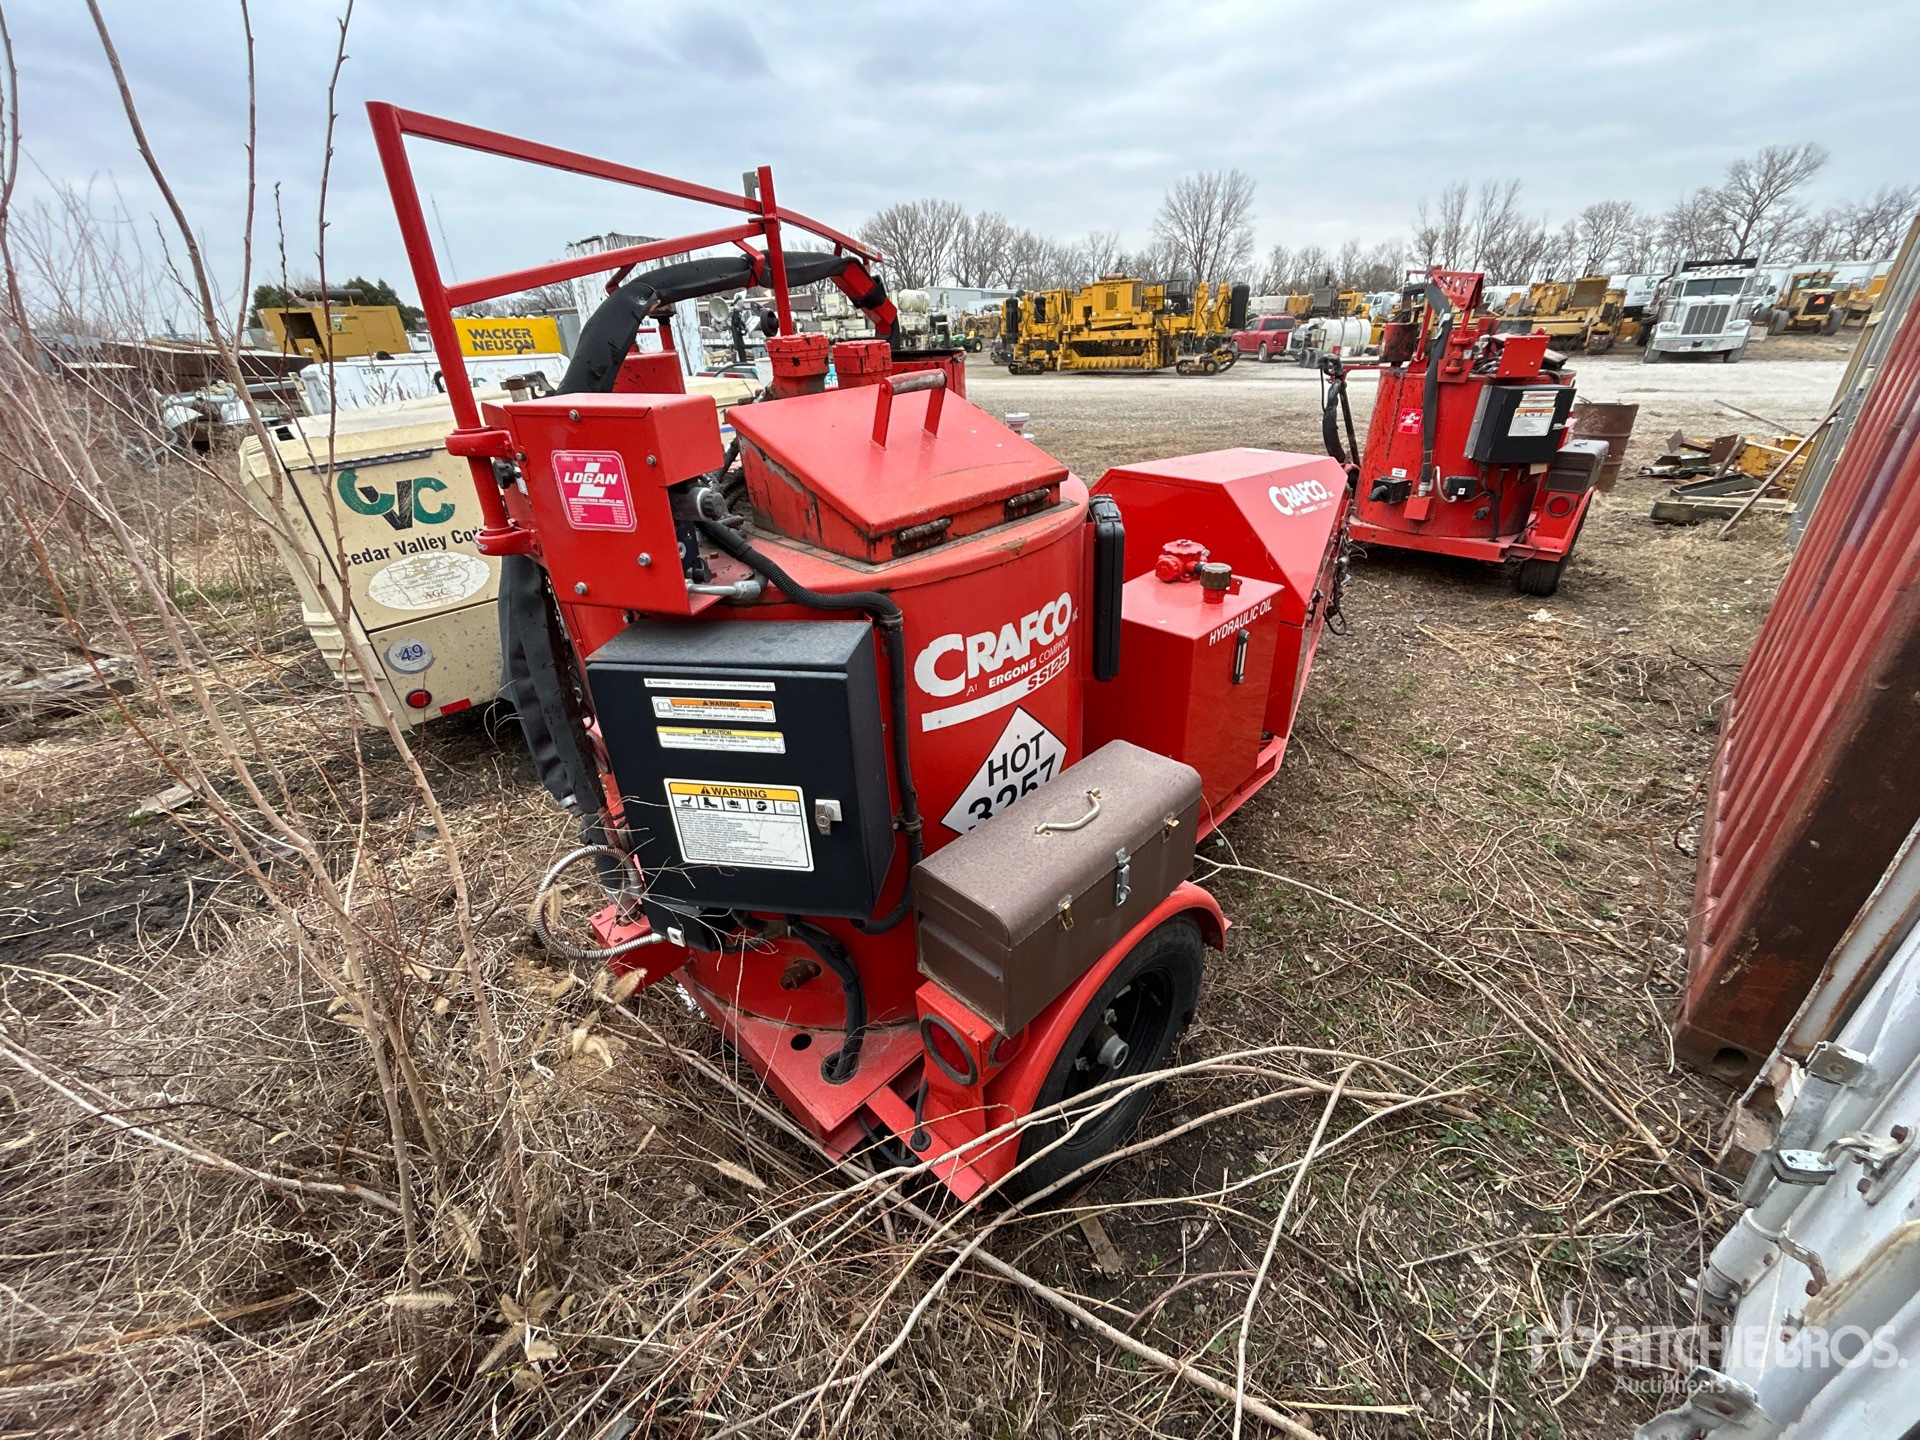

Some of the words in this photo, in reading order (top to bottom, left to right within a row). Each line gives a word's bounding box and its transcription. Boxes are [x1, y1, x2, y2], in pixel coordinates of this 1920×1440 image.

[466, 328, 532, 340] WACKER
[472, 339, 536, 351] NEUSON
[564, 472, 618, 485] LOGAN
[337, 468, 456, 530] CVC
[1268, 480, 1328, 516] CRAFCO
[394, 536, 447, 556] Valley
[1209, 610, 1258, 646] HYDRAULIC
[1259, 598, 1272, 614] OIL
[401, 644, 423, 661] 49
[914, 592, 1072, 697] CRAFCO
[988, 664, 1028, 688] ERGON
[1038, 636, 1069, 664] COMPANY
[1027, 651, 1068, 691] SS125
[988, 730, 1045, 787] HOT
[711, 787, 767, 798] WARNING
